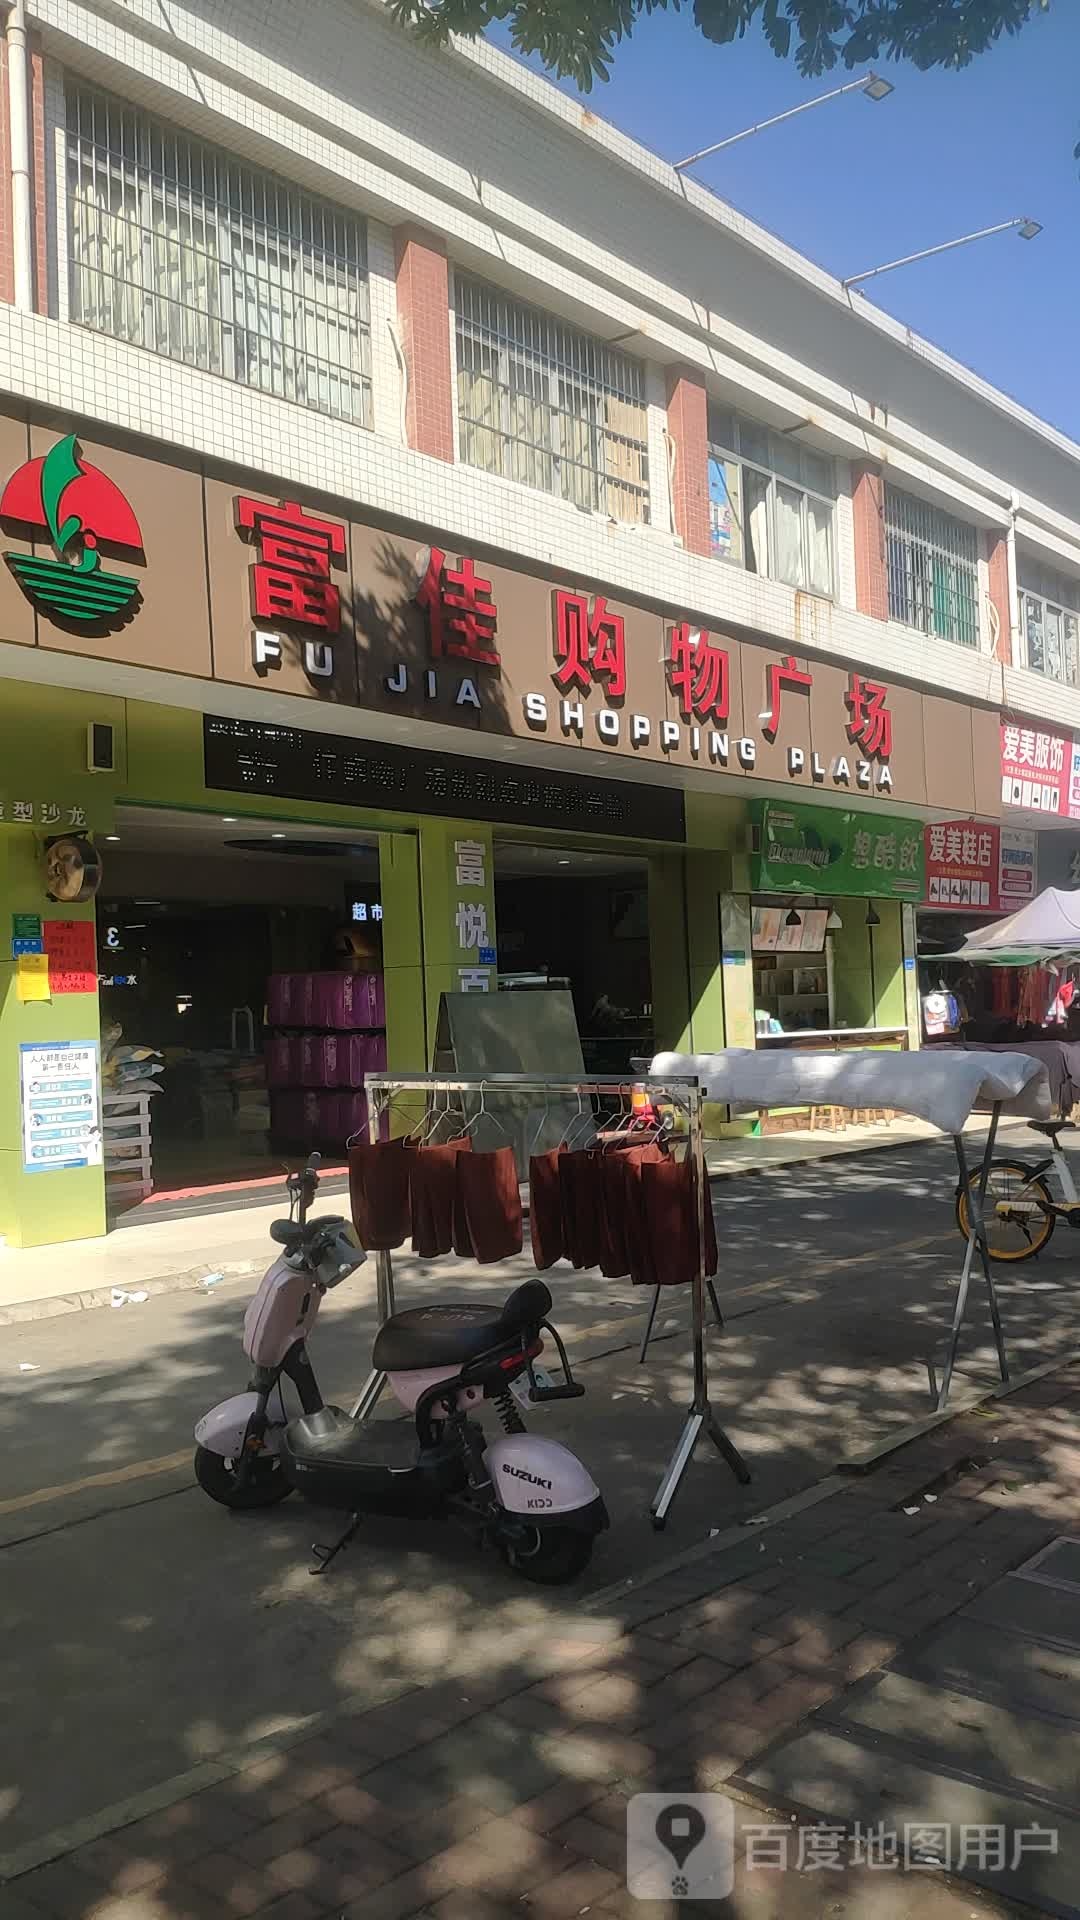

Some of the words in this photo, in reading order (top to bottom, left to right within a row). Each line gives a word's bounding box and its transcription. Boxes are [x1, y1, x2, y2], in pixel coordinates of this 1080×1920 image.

[233, 494, 893, 759] 富佳购物广场
[254, 630, 335, 677] FU
[386, 662, 482, 709] JIA
[522, 692, 757, 763] SHOPPING
[789, 746, 895, 787] PLAZA
[1002, 726, 1065, 773] 爱美服饰
[0, 801, 87, 827] 型沙龙
[929, 825, 993, 867] 爱美鞋店
[351, 901, 384, 921] 超市
[502, 1463, 553, 1491] SUZUKI
